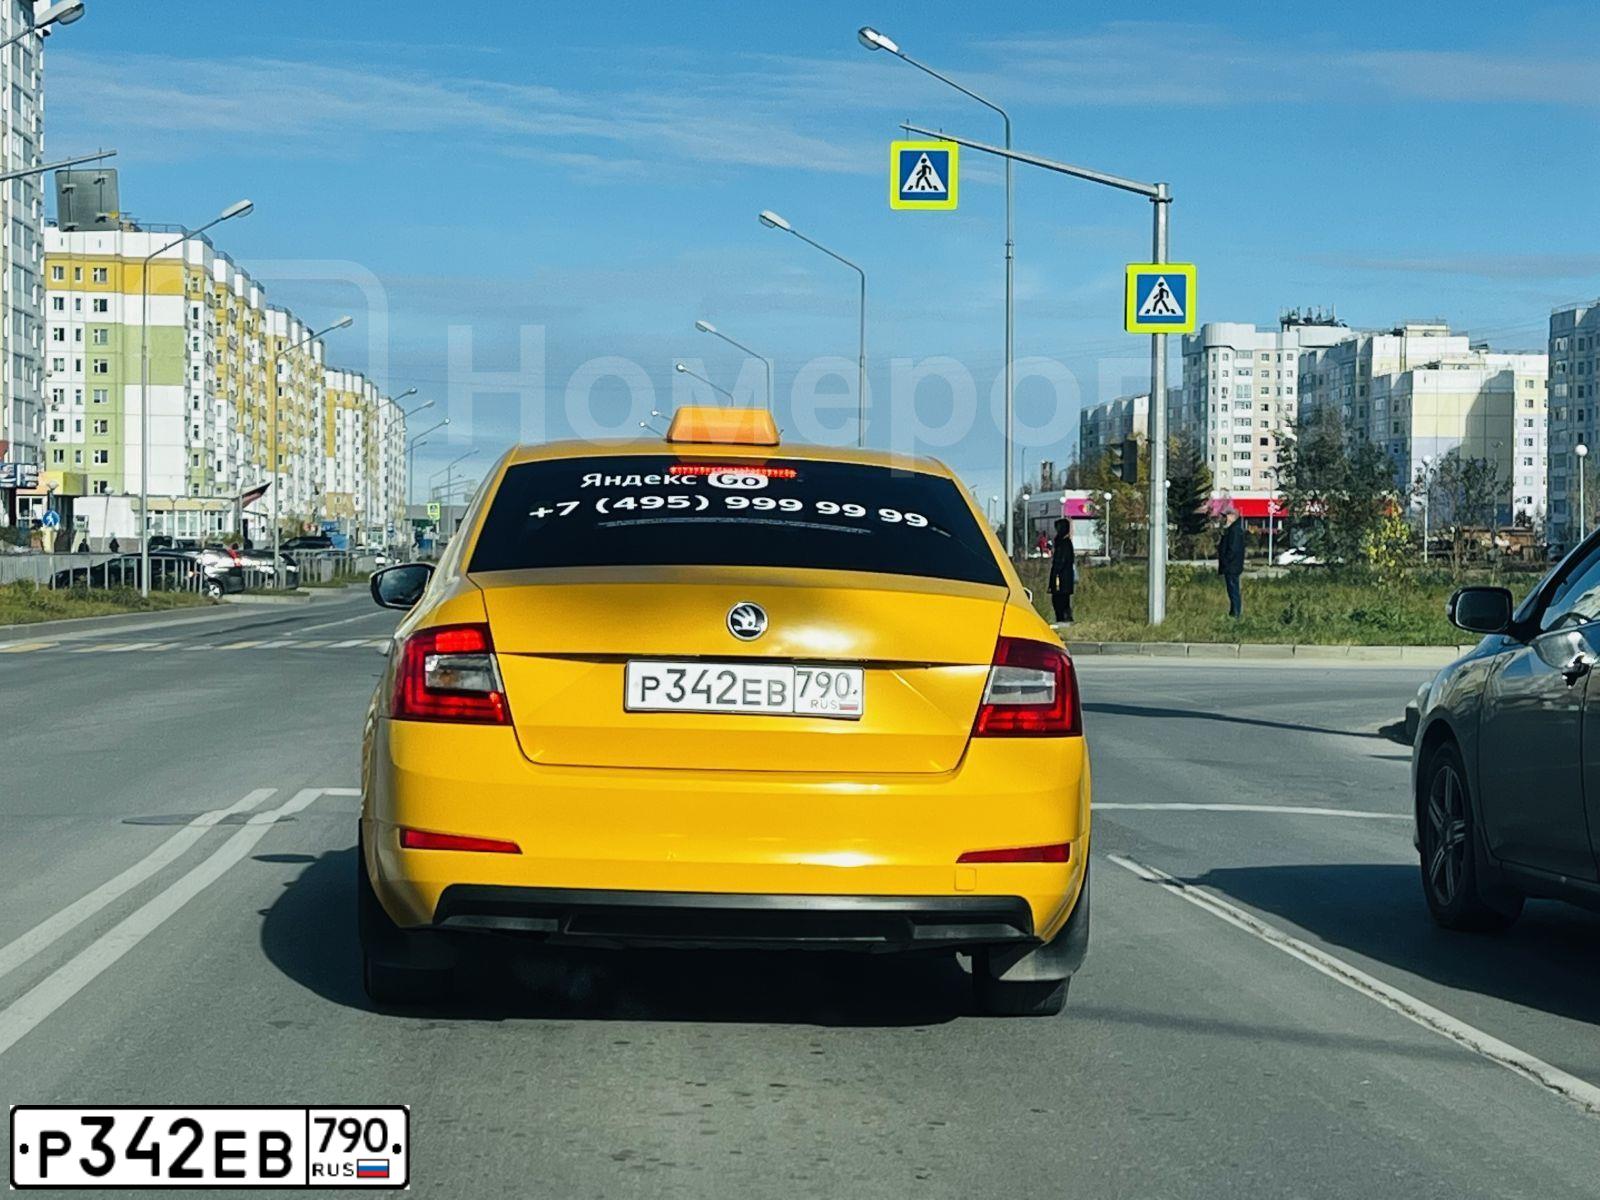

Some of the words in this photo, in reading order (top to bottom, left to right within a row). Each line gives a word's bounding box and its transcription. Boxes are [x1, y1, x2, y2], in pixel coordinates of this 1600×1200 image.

[580, 472, 697, 488] Яндекс
[713, 472, 764, 488] Go
[529, 501, 580, 518] +7
[595, 495, 709, 514] (495)
[724, 496, 803, 512] 999
[815, 501, 866, 518] 99
[878, 508, 929, 528] 99
[641, 668, 787, 706] Р342ЕВ
[796, 671, 851, 699] 790
[810, 699, 838, 710] RUS
